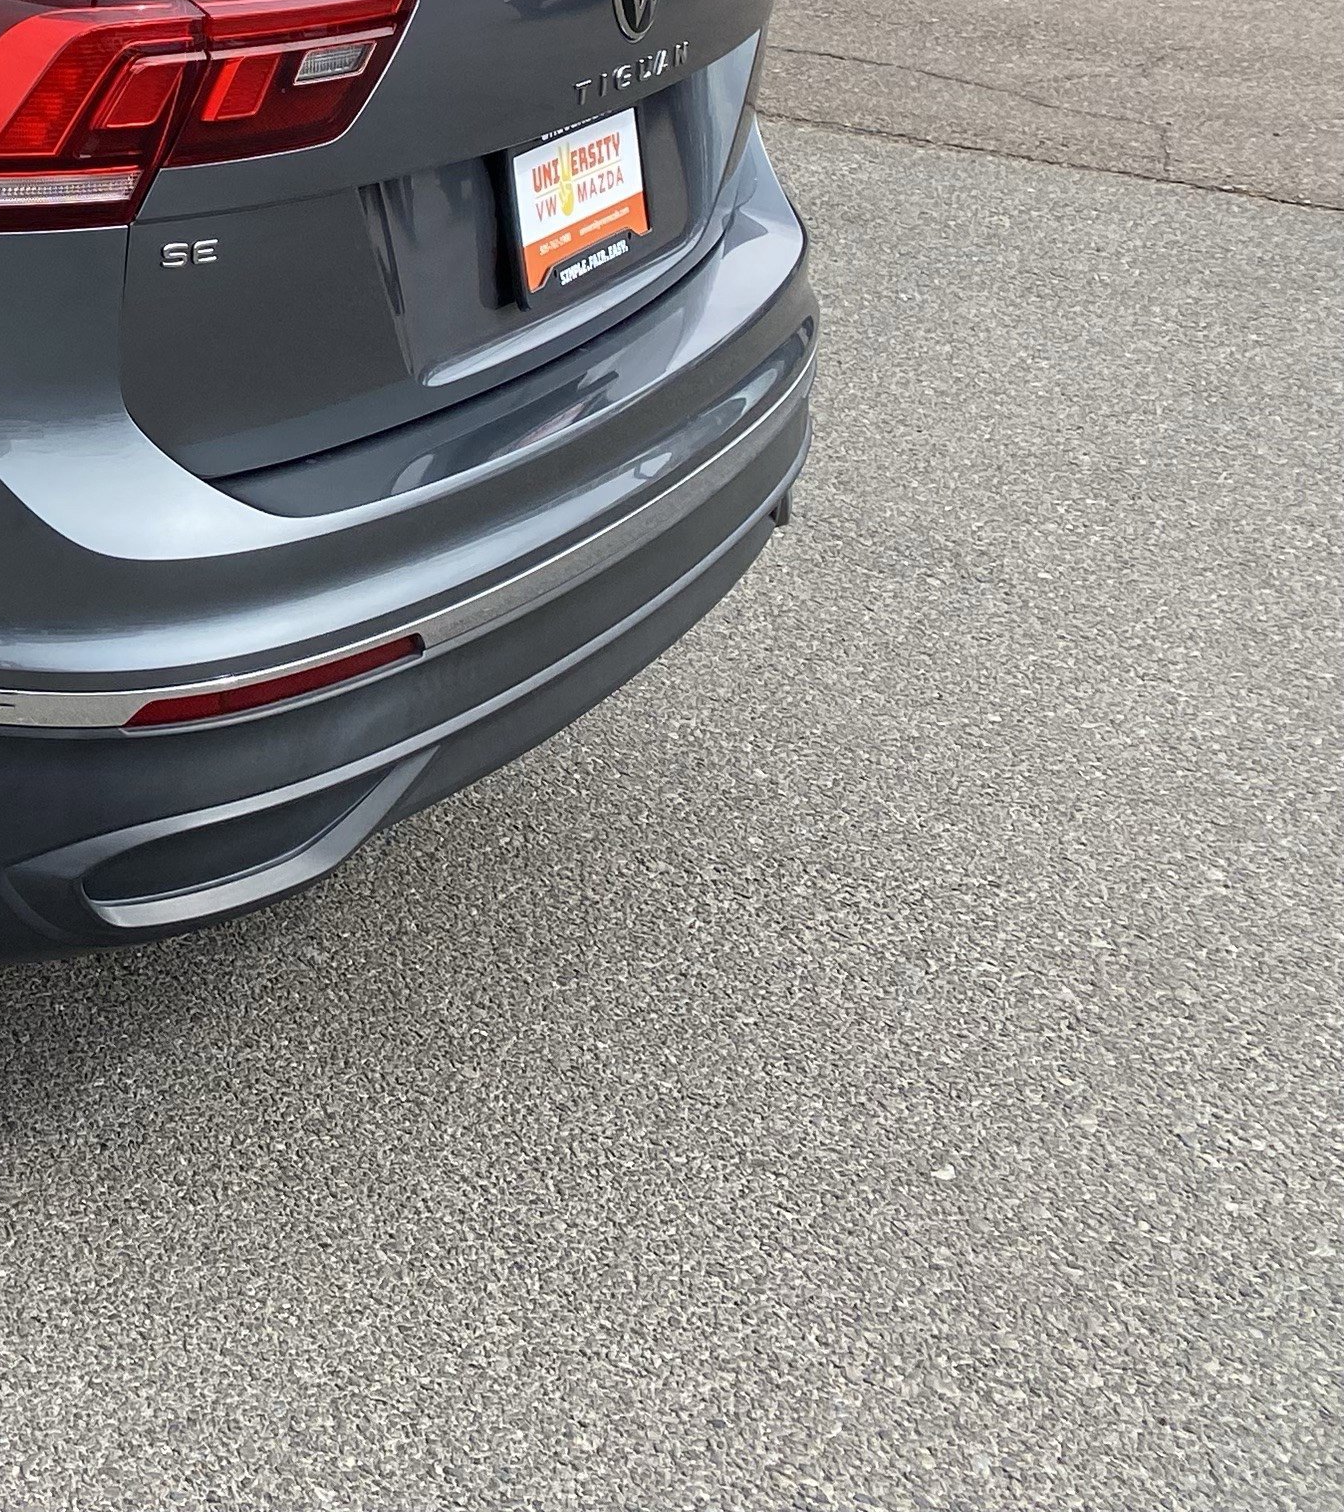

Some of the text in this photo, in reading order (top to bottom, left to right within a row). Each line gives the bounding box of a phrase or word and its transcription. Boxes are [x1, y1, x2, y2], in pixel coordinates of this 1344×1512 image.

[574, 40, 690, 106] TIGUAN
[535, 194, 558, 222] VW
[576, 165, 624, 203] MAZDA
[160, 238, 219, 268] SE
